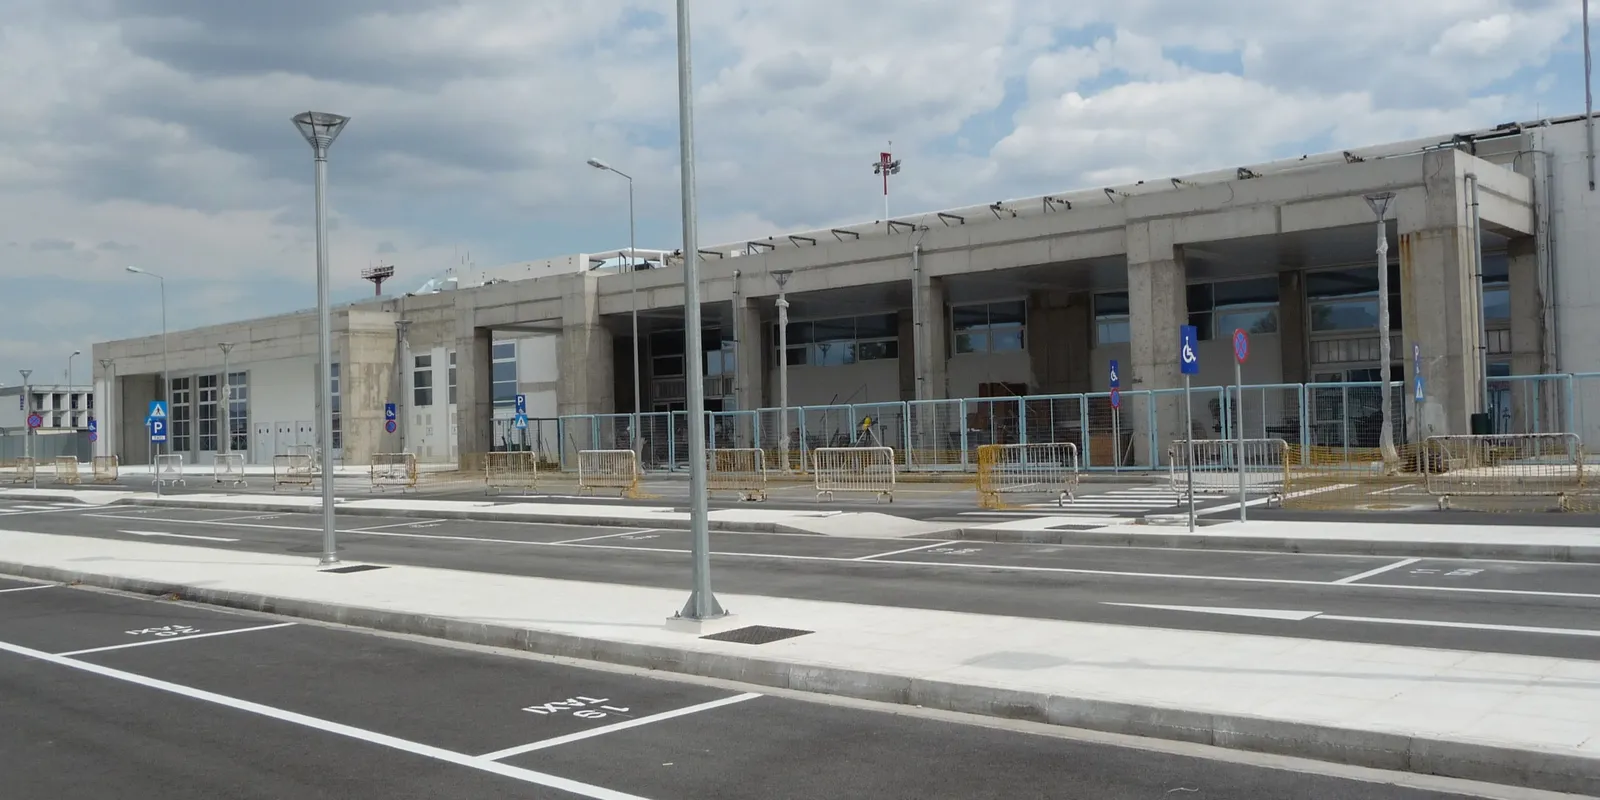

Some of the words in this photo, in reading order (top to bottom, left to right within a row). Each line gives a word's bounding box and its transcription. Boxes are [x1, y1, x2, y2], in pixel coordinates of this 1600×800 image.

[1414, 345, 1420, 361] P
[517, 396, 524, 406] P
[154, 421, 163, 434] P
[124, 624, 192, 635] TAXI
[521, 695, 609, 715] TAXI
